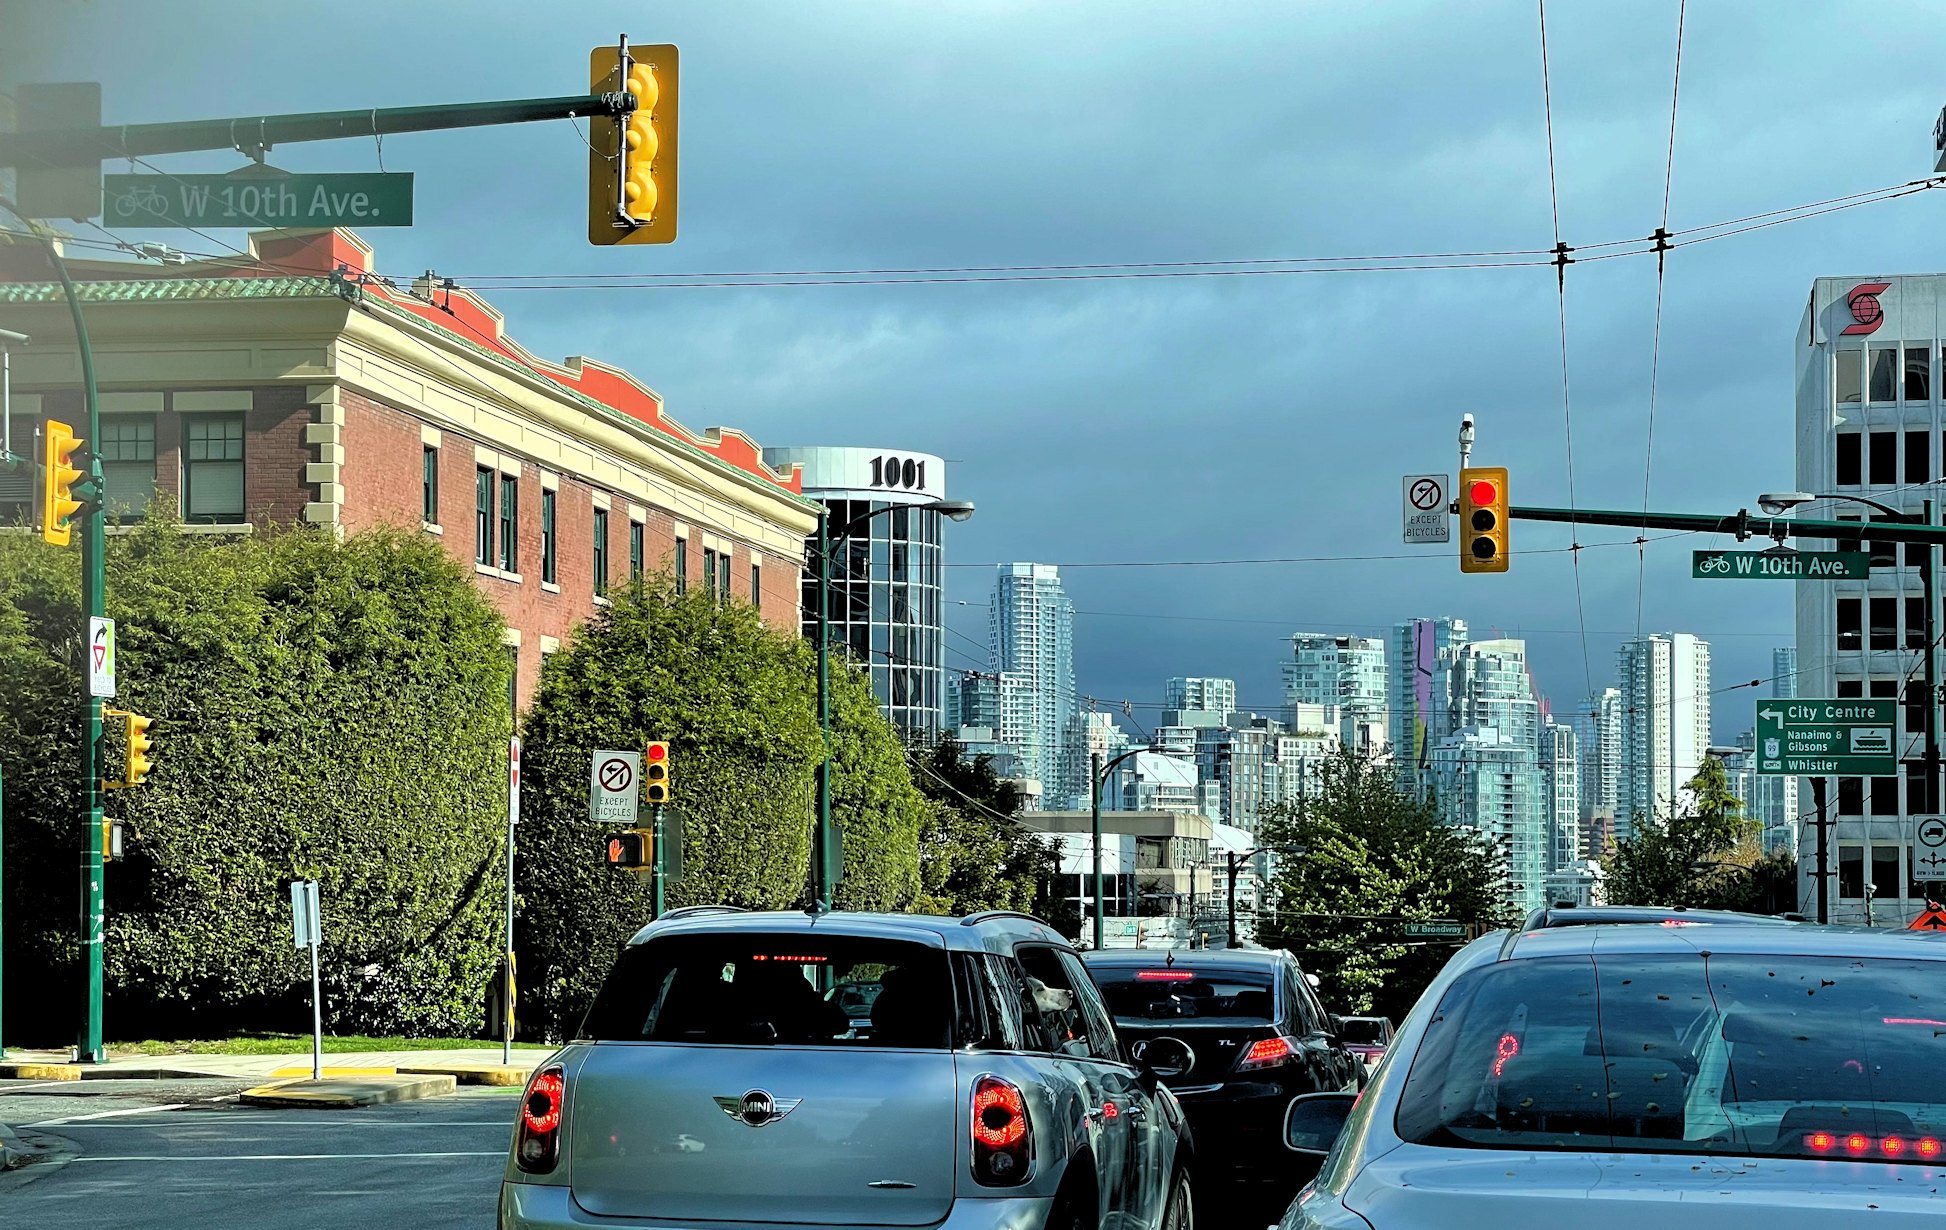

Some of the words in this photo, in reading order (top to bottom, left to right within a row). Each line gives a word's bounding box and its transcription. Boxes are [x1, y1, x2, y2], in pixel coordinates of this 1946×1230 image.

[180, 185, 208, 217] W
[221, 184, 297, 217] 10th
[308, 184, 380, 217] Ave.
[869, 456, 926, 490] 1001
[1410, 515, 1442, 524] EXCEPT
[1406, 527, 1446, 537] BICYCLES
[1735, 556, 1754, 574] W
[1759, 556, 1803, 574] 10th
[1808, 556, 1850, 575] Ave.
[1788, 705, 1817, 721] City
[1825, 706, 1876, 718] Centre
[1787, 730, 1832, 740] Nanaimo
[1835, 730, 1842, 740] &
[1767, 744, 1777, 752] 99
[1788, 742, 1828, 752] Gibsons
[1788, 760, 1838, 771] Whistler
[599, 797, 628, 806] EXCEPT
[595, 807, 632, 816] BICYCLES
[1410, 925, 1419, 933] W
[1421, 925, 1462, 934] Broadway
[743, 1101, 770, 1113] MINI
